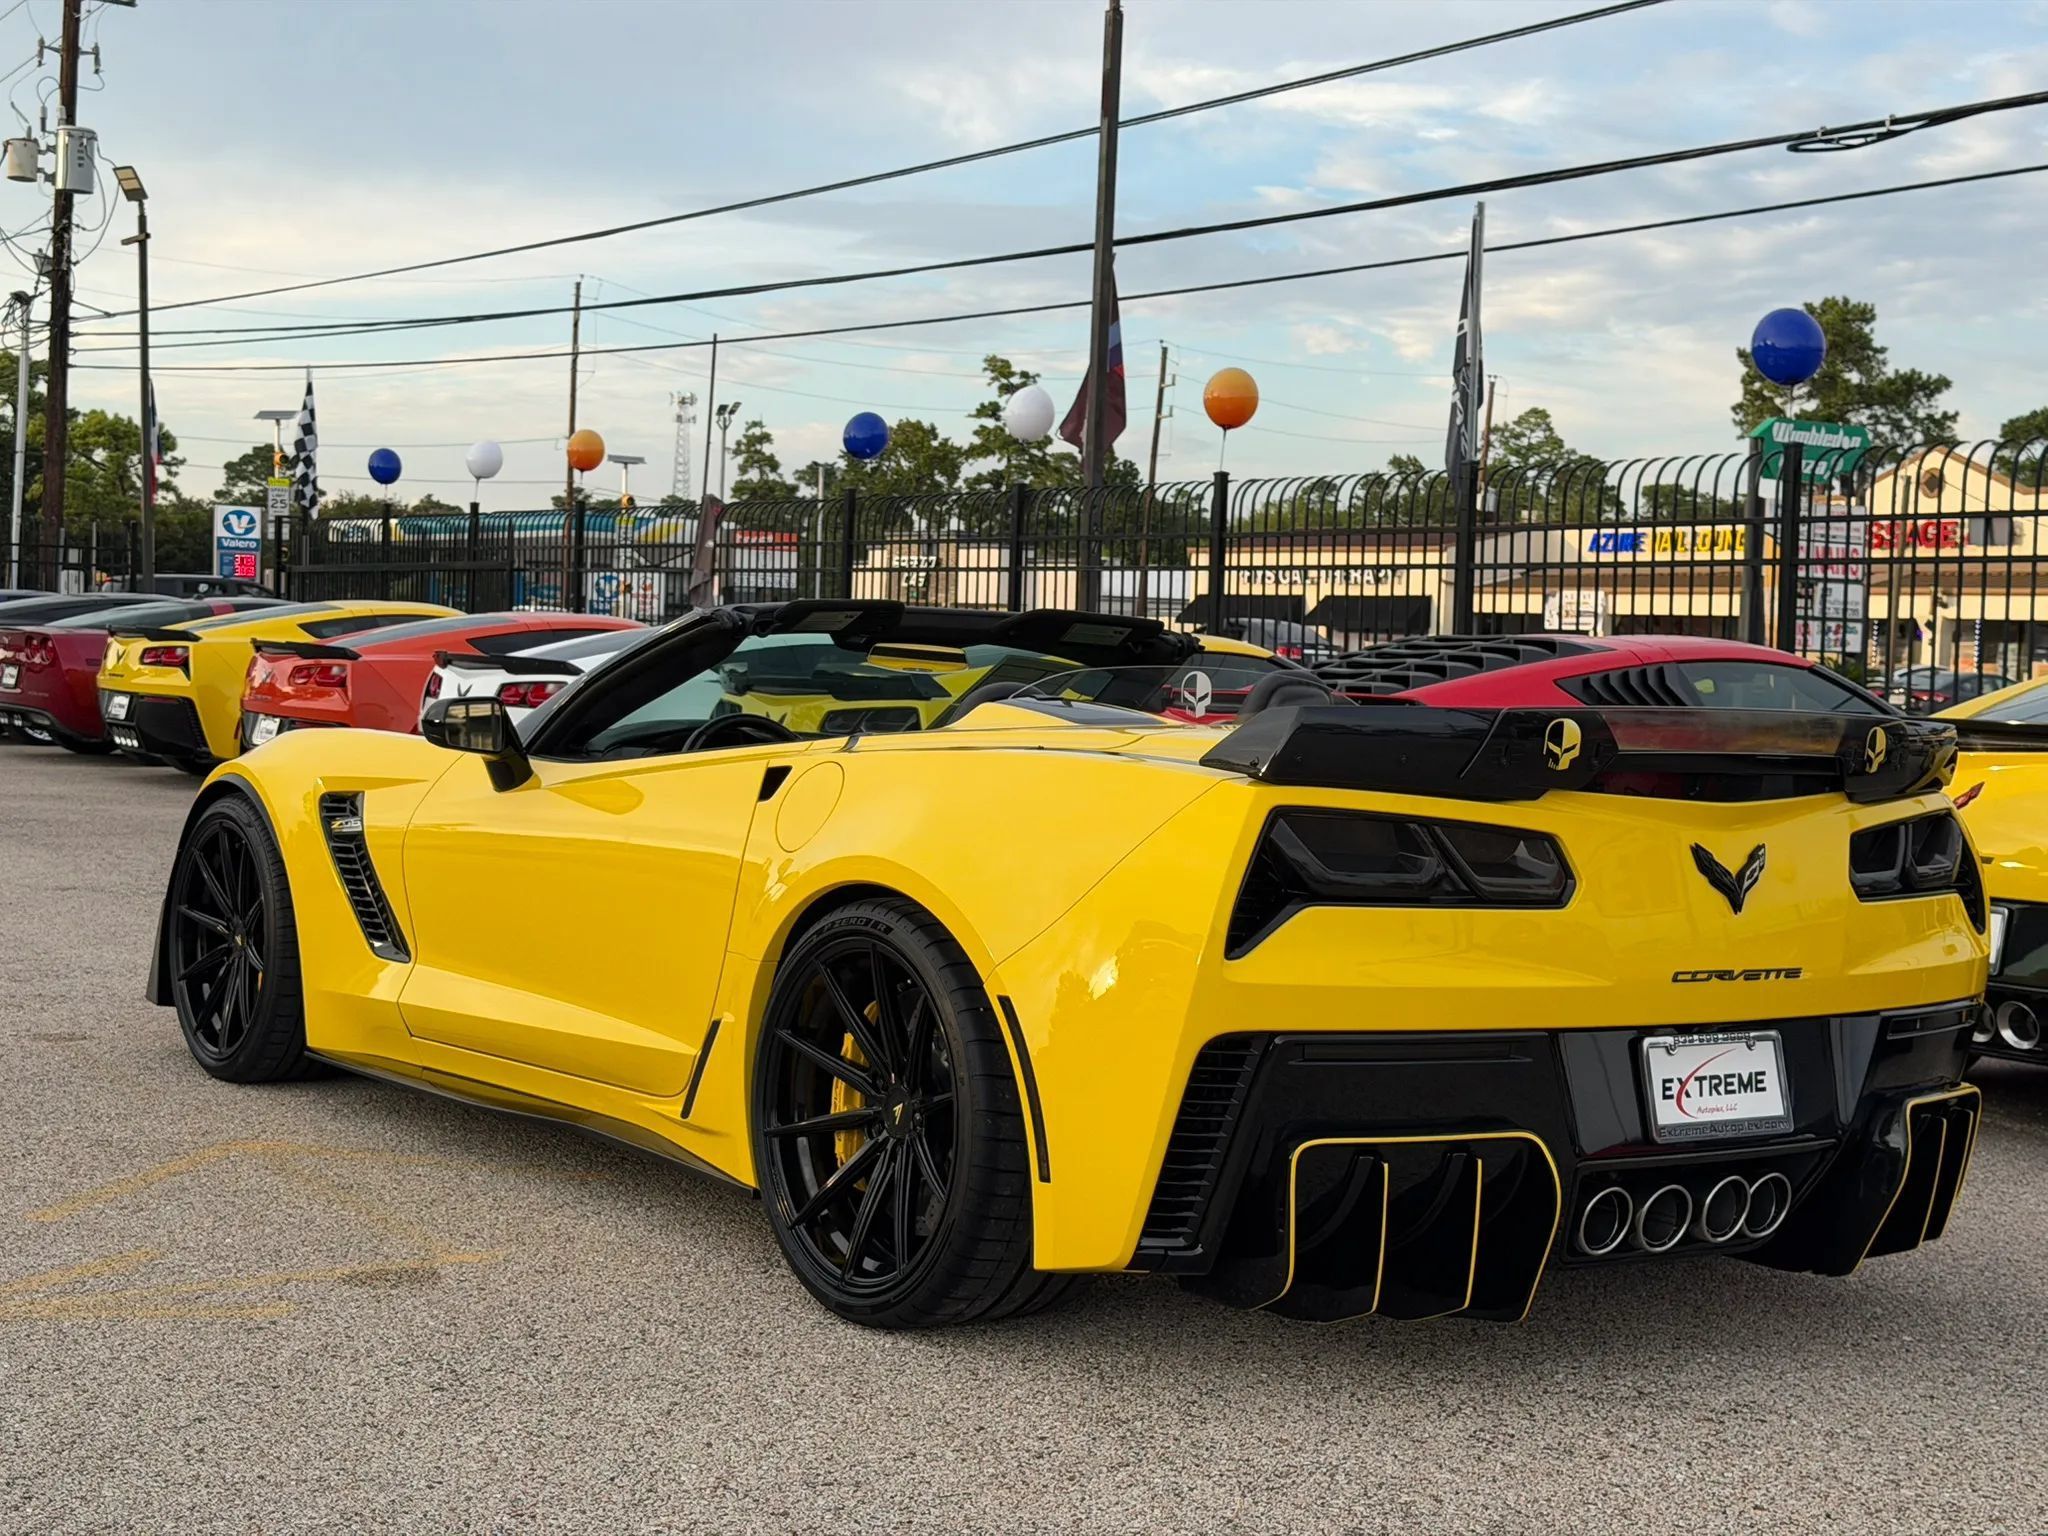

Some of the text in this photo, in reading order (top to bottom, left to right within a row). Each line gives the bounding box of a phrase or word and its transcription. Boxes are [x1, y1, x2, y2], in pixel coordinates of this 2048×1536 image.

[1772, 422, 1861, 449] Wimbledon
[271, 499, 288, 508] 25
[222, 539, 257, 548] Valero
[1652, 530, 1688, 552] AL
[1672, 967, 1802, 982] CORVETTE
[1662, 1071, 1767, 1100] EXTREME
[1659, 1119, 1790, 1137] ExtremeAutoplex.com
